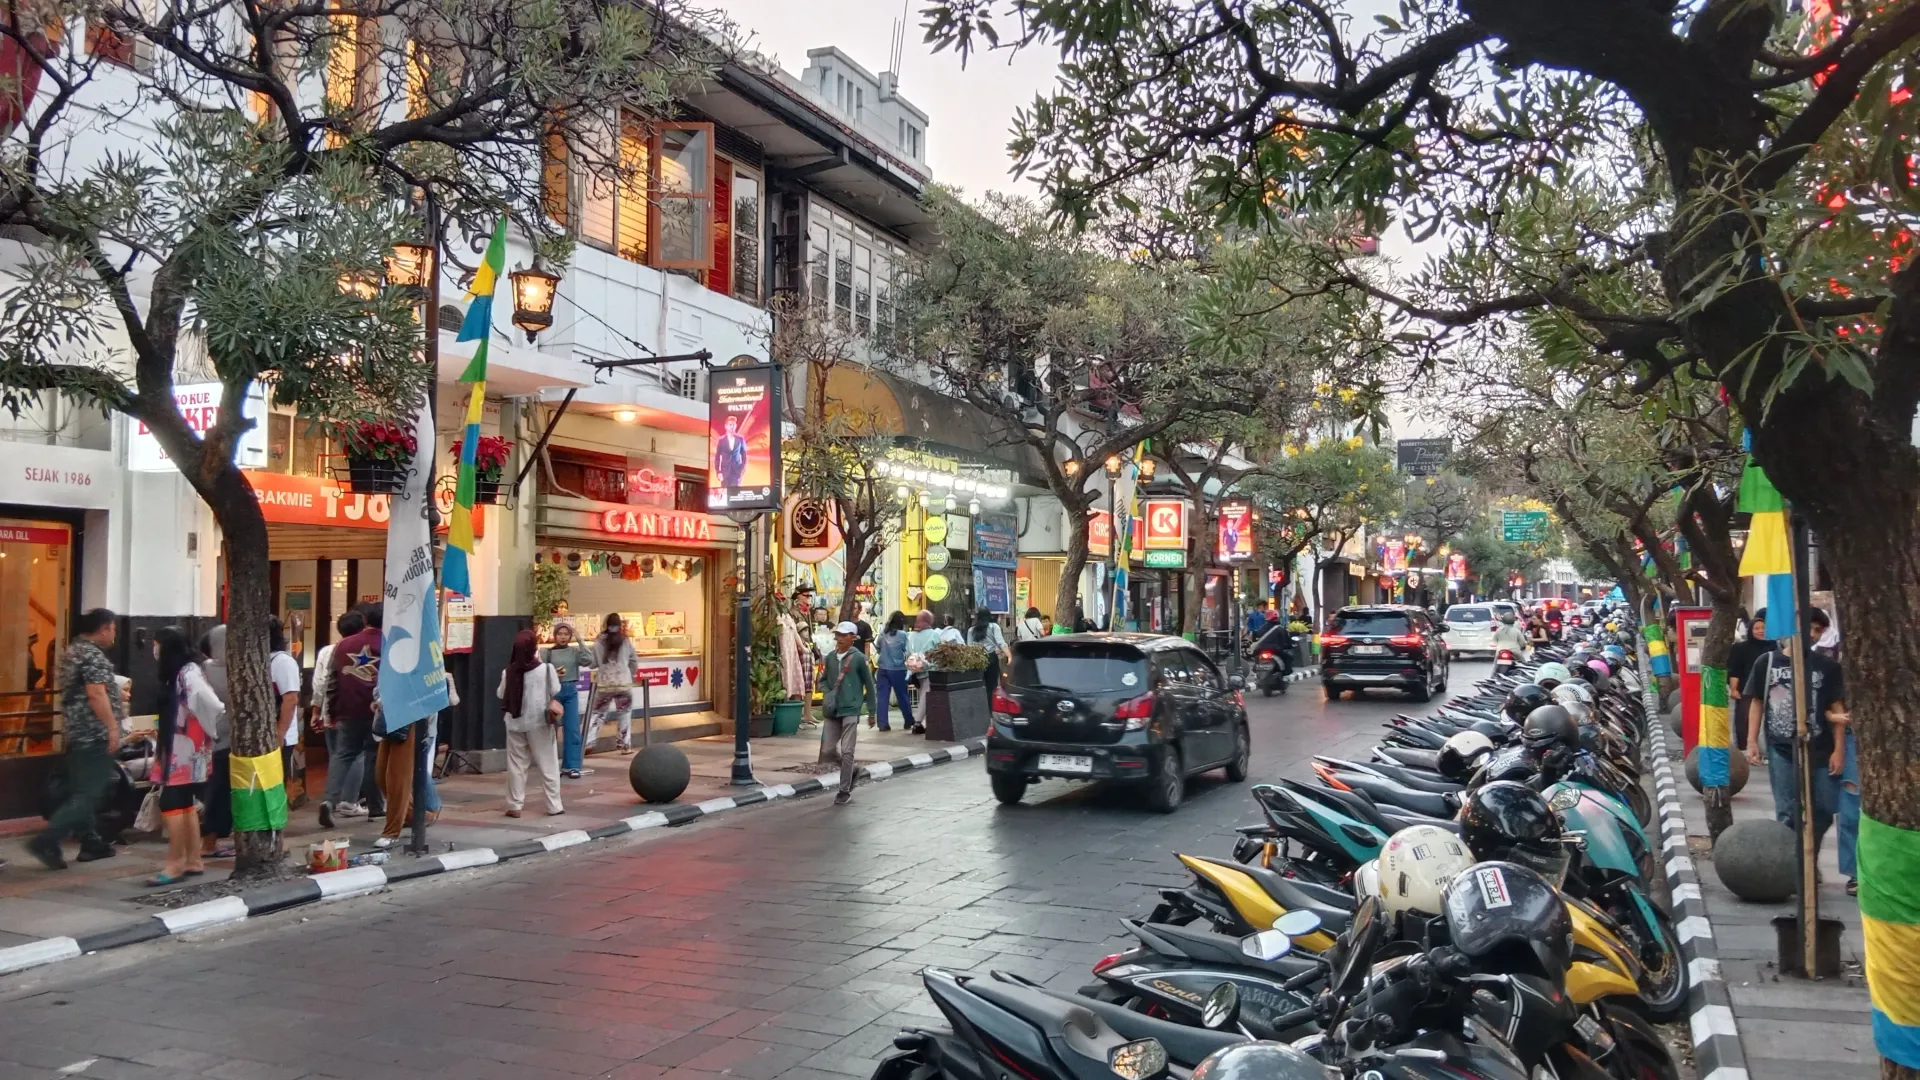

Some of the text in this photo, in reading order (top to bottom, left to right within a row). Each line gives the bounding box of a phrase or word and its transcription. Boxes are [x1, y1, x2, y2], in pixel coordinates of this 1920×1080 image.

[189, 391, 210, 405] KUE
[25, 467, 91, 486] SEJAK 1986
[257, 489, 313, 508] BAKMIE
[605, 509, 710, 540] CANTINA
[16, 530, 30, 541] DLL
[1146, 553, 1183, 565] KORNER
